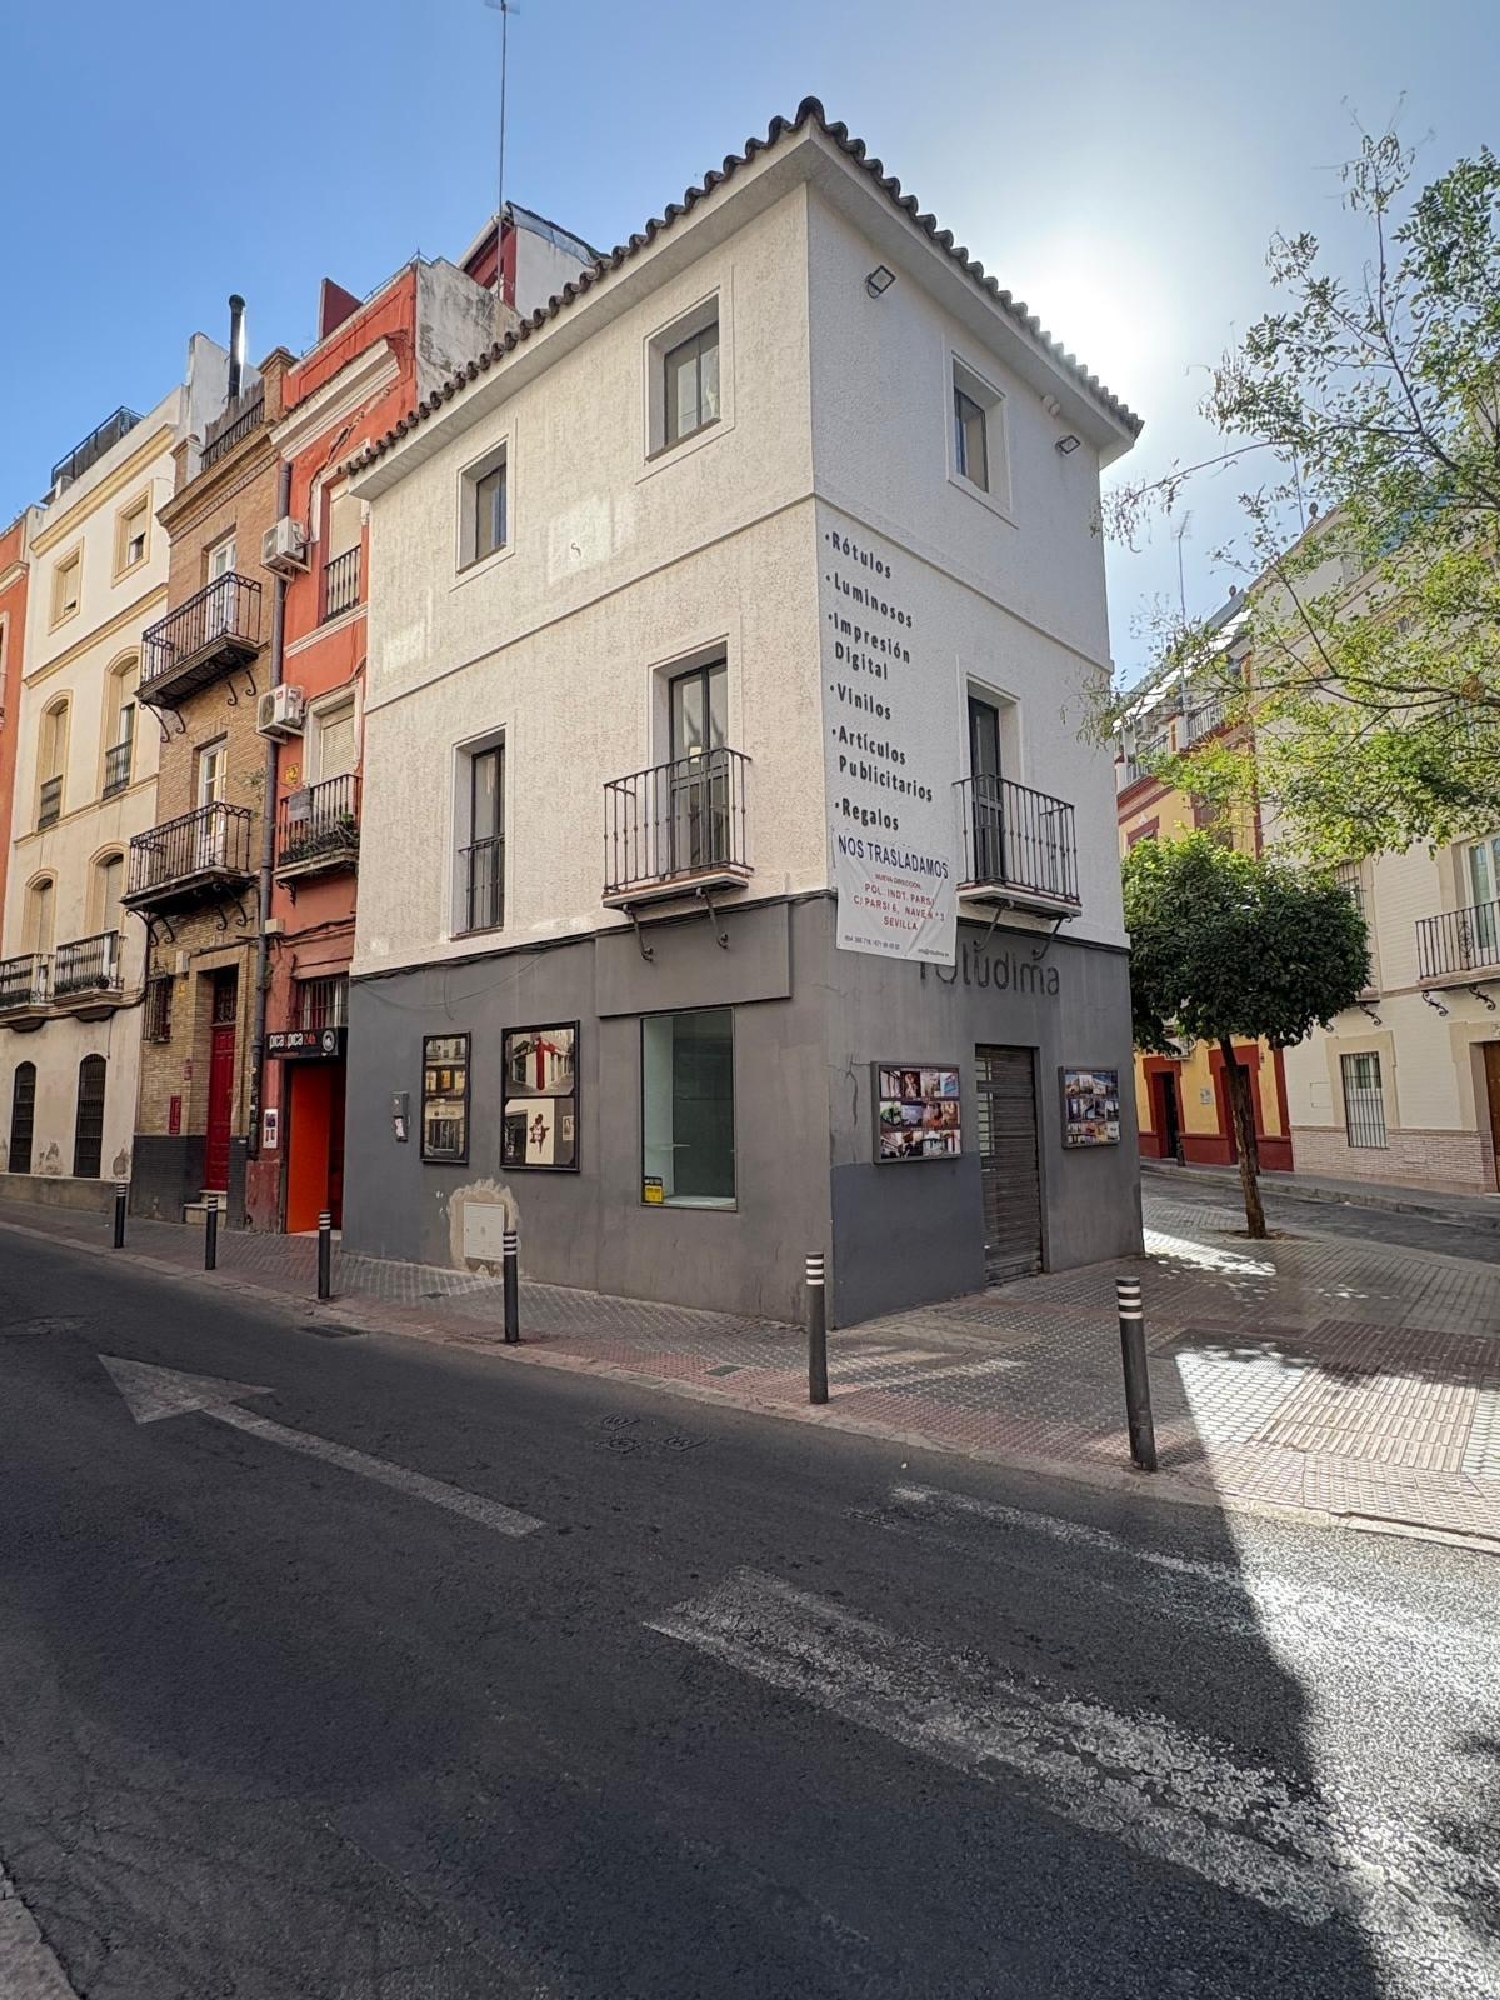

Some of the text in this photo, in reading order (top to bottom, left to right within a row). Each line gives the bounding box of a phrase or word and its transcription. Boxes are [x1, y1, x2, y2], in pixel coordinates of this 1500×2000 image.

[834, 573, 912, 628] Luminosos
[835, 641, 888, 680] Digital
[838, 683, 891, 720] Vinilos
[839, 755, 932, 802] Publicitarios
[842, 798, 899, 830] Regalos
[838, 834, 949, 879] NOS TRASLADAMOS
